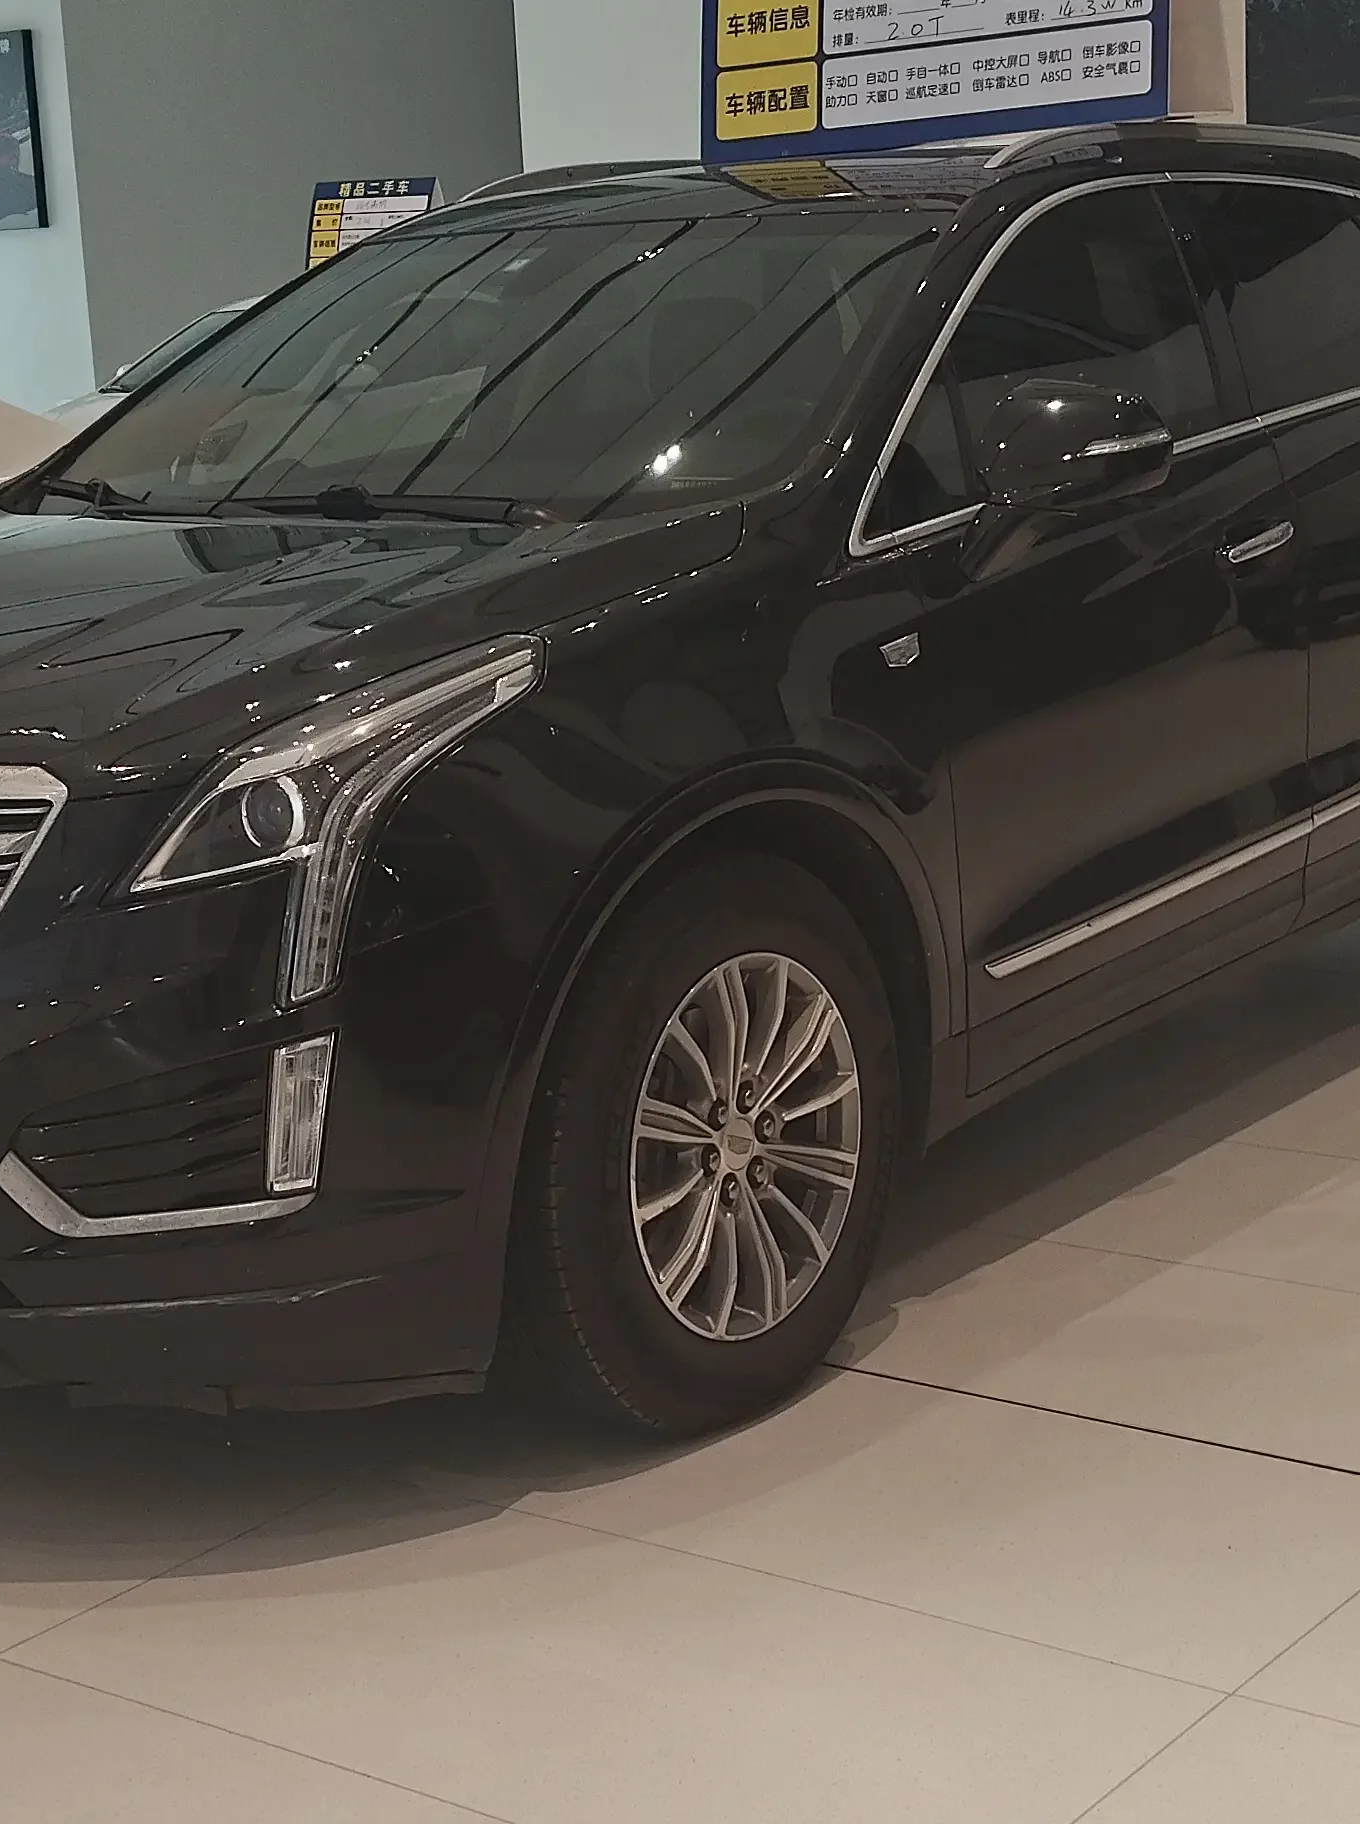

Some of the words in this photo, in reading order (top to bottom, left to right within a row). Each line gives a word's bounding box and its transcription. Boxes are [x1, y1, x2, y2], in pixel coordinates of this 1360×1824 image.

[726, 5, 810, 37] 车辆信息
[725, 84, 809, 117] 车辆配置
[338, 180, 410, 198] 精品二手车
